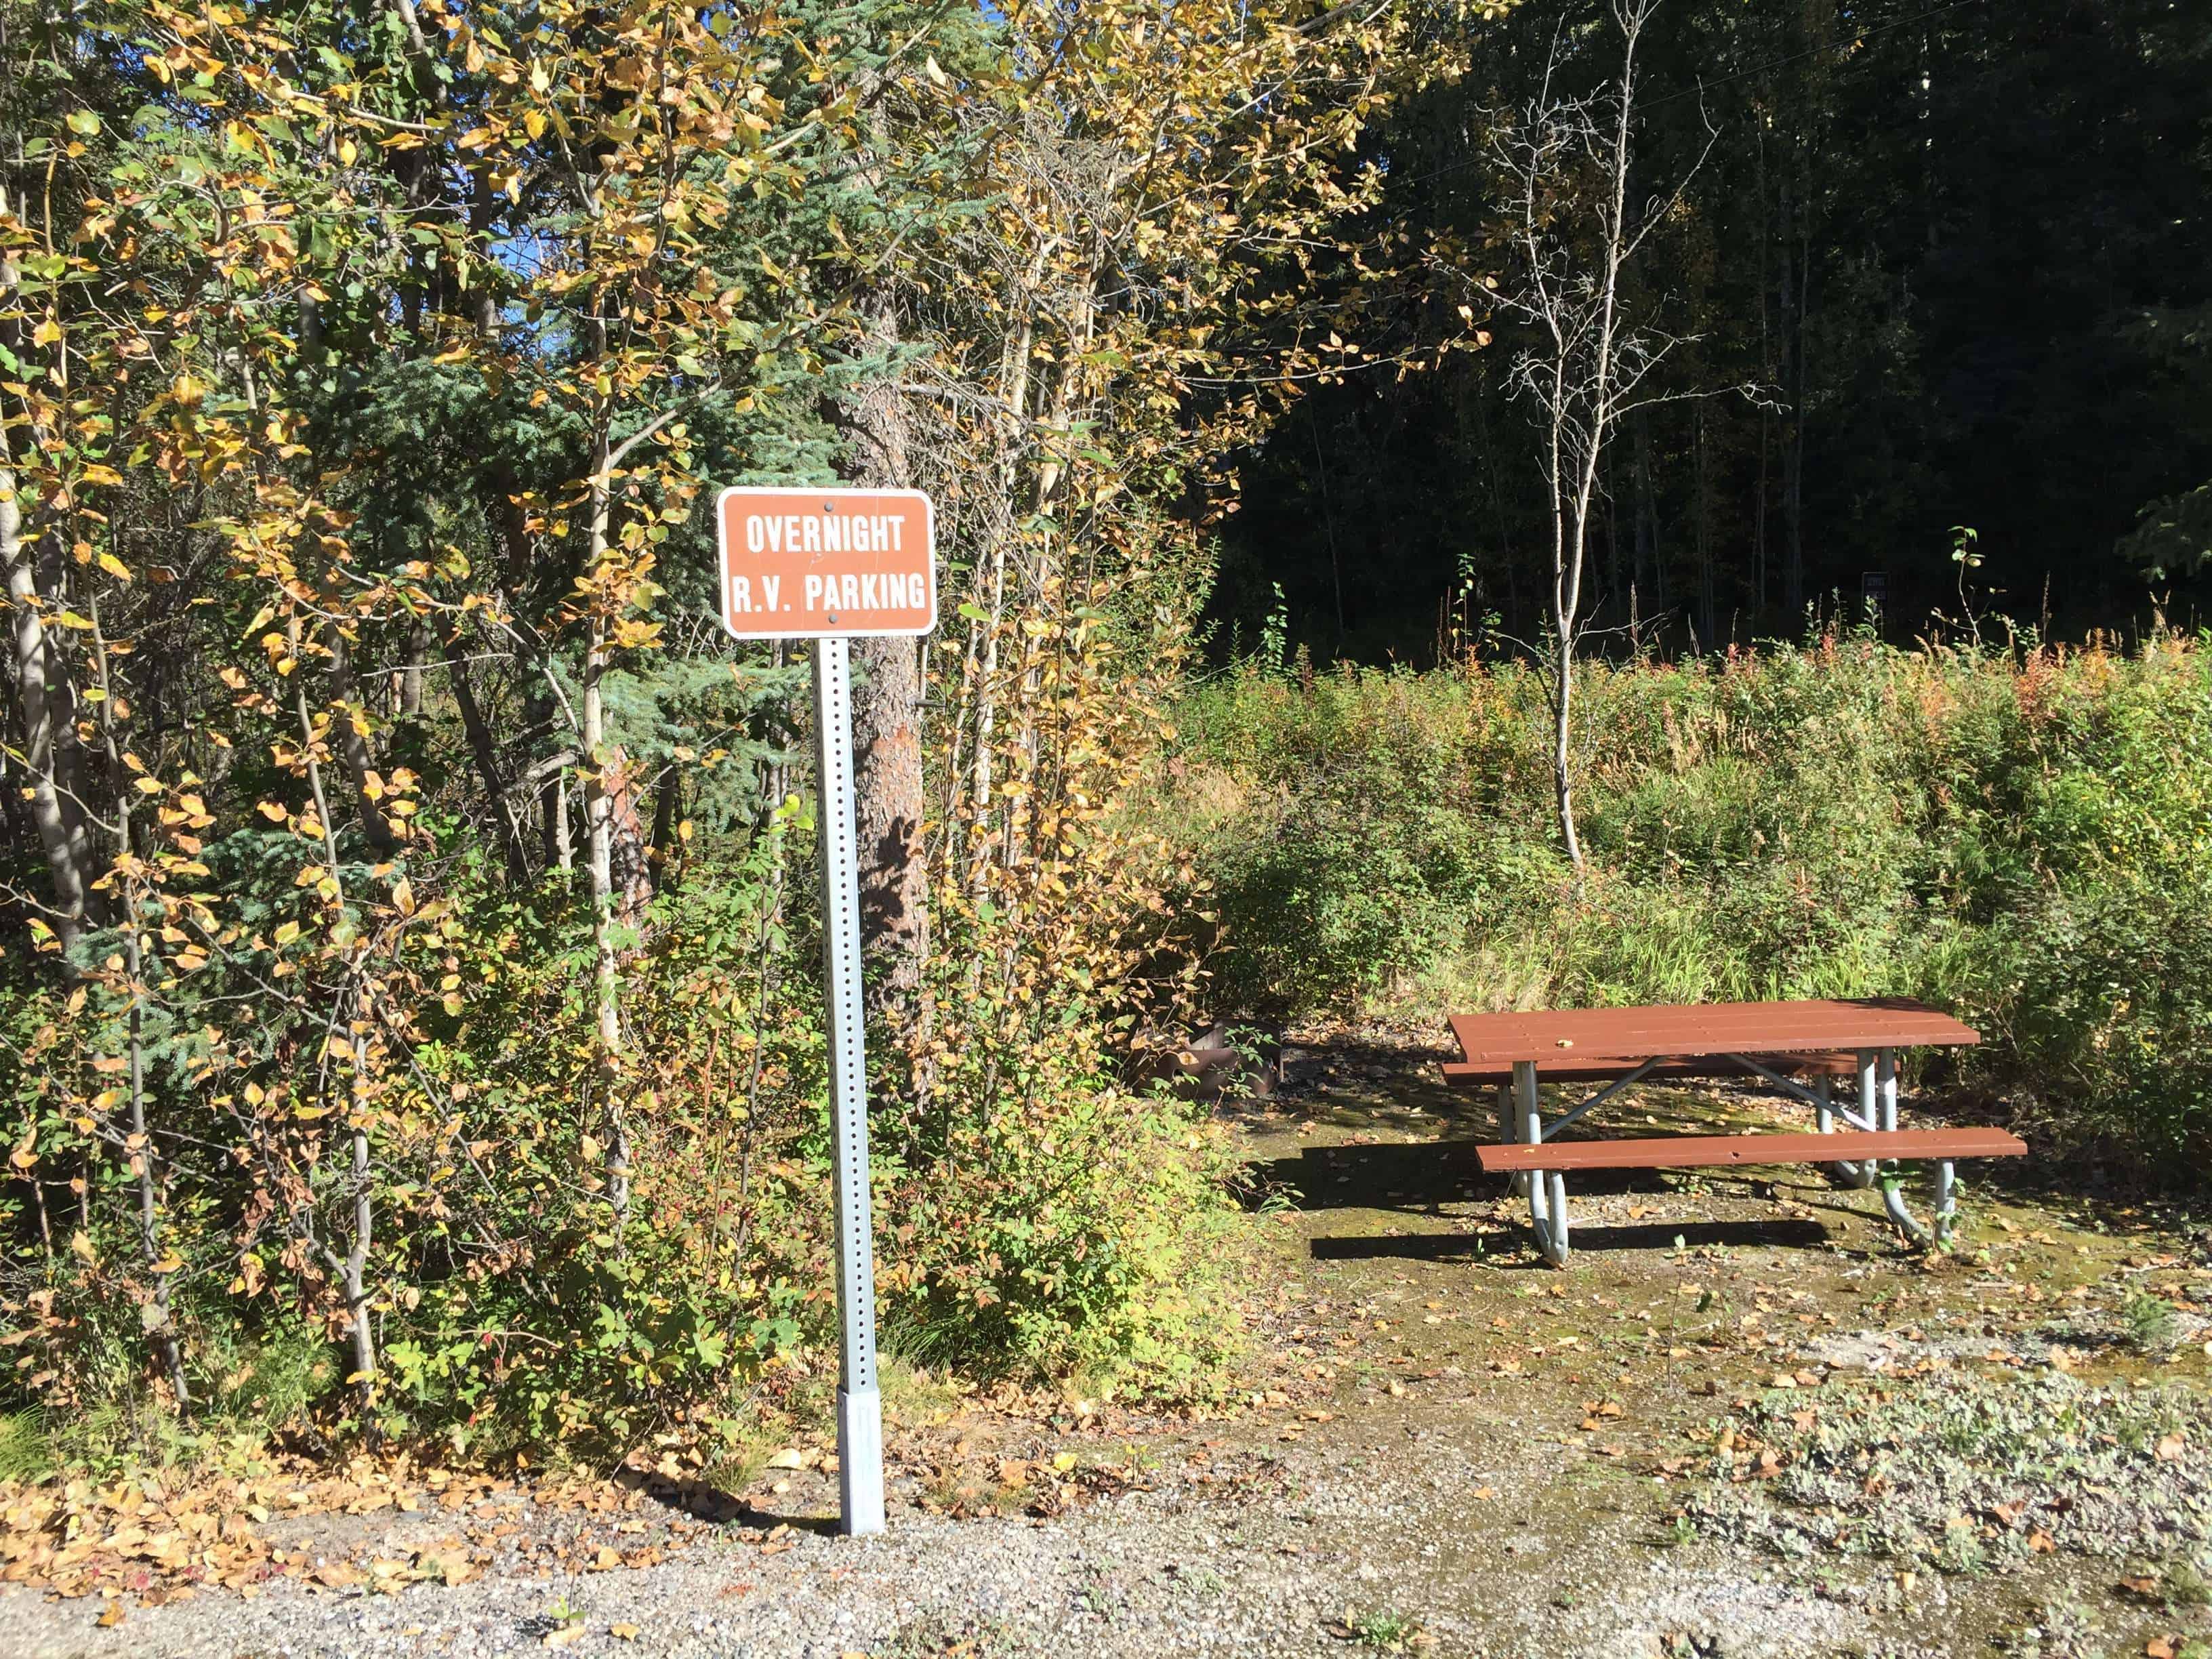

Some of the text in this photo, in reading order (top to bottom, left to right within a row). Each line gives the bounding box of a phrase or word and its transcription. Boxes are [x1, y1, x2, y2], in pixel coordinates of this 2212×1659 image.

[746, 515, 905, 552] OVERNIGHT
[733, 573, 926, 613] R.V. PARKING
